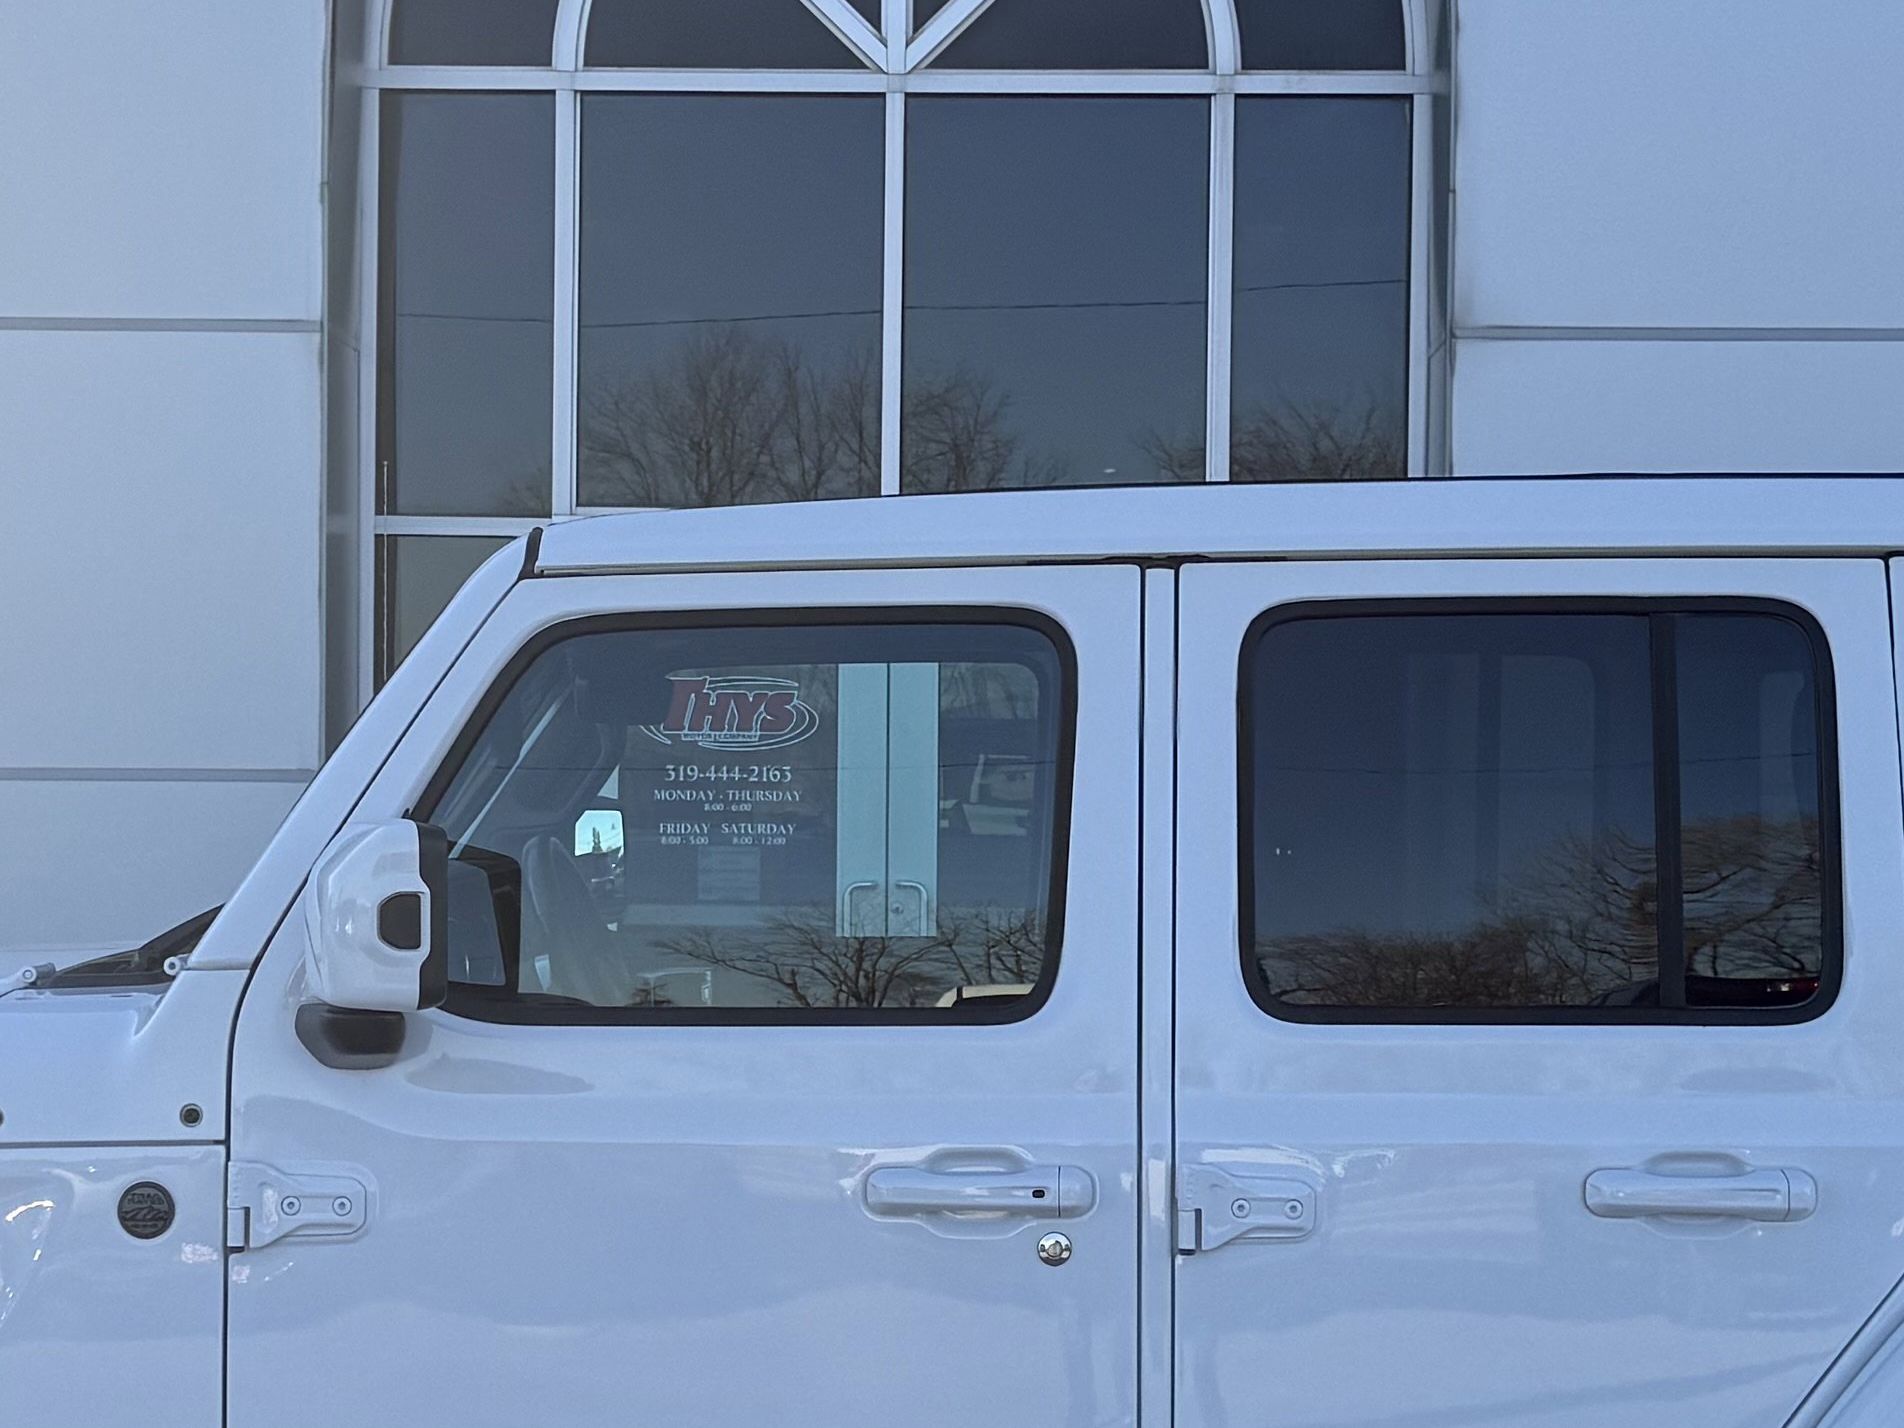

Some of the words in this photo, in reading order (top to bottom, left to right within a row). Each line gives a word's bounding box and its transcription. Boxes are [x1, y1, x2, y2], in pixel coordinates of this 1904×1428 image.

[660, 675, 798, 734] THYS
[664, 764, 793, 783] 319-444-2163
[654, 788, 716, 802] MONDAY
[725, 789, 803, 802] THURSDAY
[658, 822, 711, 835] FRIDAY
[721, 823, 797, 835] SATURDAY
